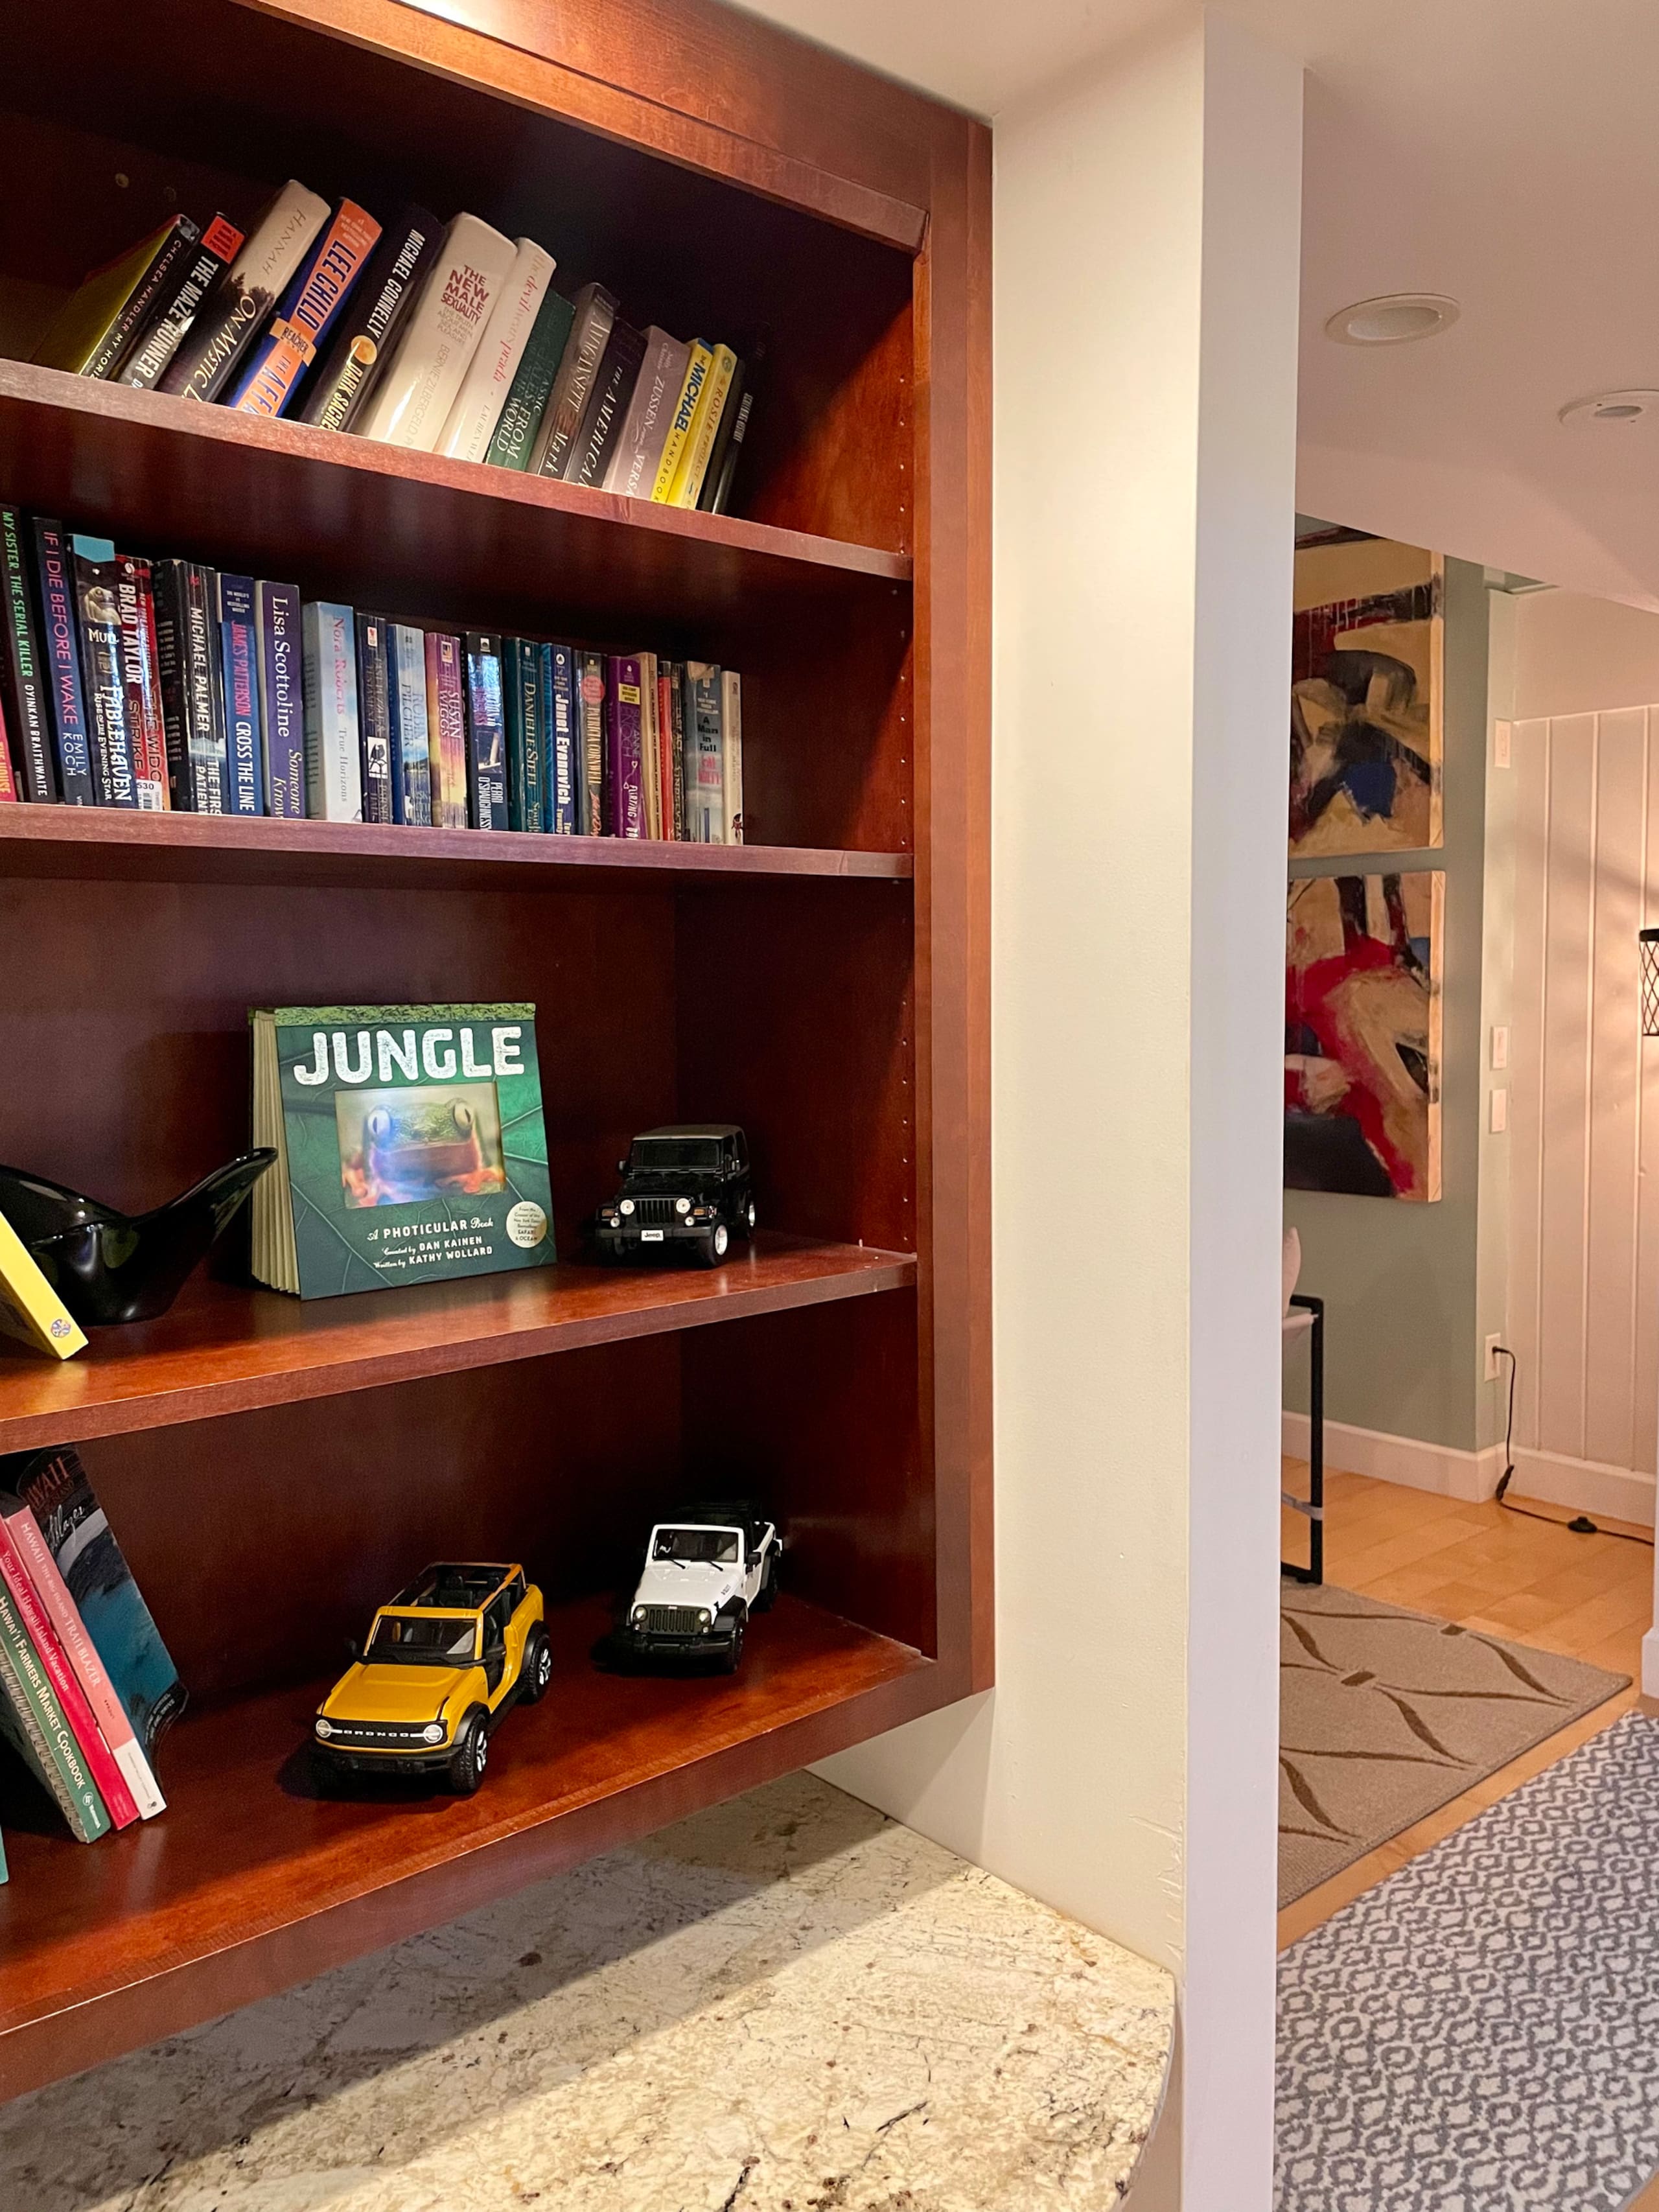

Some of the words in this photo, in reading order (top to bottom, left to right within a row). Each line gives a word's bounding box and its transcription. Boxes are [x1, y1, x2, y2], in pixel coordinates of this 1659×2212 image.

[152, 239, 181, 283] CHELSEA
[262, 207, 307, 275] HANNAH
[322, 240, 357, 283] LEE
[392, 228, 426, 281] MICHAEL
[191, 255, 219, 287] THE
[449, 269, 489, 302] NEW
[463, 264, 487, 285] THE
[121, 285, 154, 332] HANDLER
[168, 281, 203, 324] MAZE
[231, 295, 257, 330] ON
[296, 272, 339, 331] CHILD
[366, 279, 403, 339] CONNELLY
[440, 292, 481, 325] SEXUALITY
[445, 283, 485, 316] MALE
[518, 279, 539, 312] devil
[112, 332, 124, 349] MY
[135, 318, 184, 379] RUNNER
[194, 323, 238, 388] MYSTIC
[281, 325, 309, 353] REACHER
[431, 343, 450, 378] BERNIE
[275, 355, 292, 375] THE
[338, 360, 364, 400] DARK
[493, 340, 512, 383] prada
[612, 366, 623, 385] THE
[644, 375, 666, 431] ZUSSEN
[673, 362, 706, 433] MICHAEL
[706, 388, 724, 431] ROSIE
[496, 397, 522, 452] WORLD
[506, 406, 531, 459] FROM
[545, 430, 569, 473] Mark
[652, 433, 682, 502] HANDBOOK
[2, 511, 16, 530] MY
[43, 531, 59, 547] IF
[10, 575, 23, 597] THE
[46, 559, 64, 589] DIE
[13, 601, 29, 637] SERIAL
[118, 583, 139, 624] BRAD
[272, 595, 290, 636] Lisa
[51, 592, 72, 661] BEFORE
[191, 607, 207, 669] MICHAEL
[231, 619, 248, 657] JAMES
[333, 616, 346, 653] Nora
[17, 639, 33, 677] KILLER
[122, 629, 143, 685] TAYLOR
[24, 684, 40, 728] OYINKAN
[60, 675, 79, 725] WAKE
[194, 674, 211, 732] PALMER
[233, 658, 251, 717] PATTERSON
[274, 640, 294, 738] Scottoline
[334, 658, 348, 716] Roberts
[400, 683, 414, 747] PILCHER
[412, 693, 426, 744] ROBIN
[439, 690, 452, 738] WIGGS
[447, 690, 462, 739] SUSAN
[524, 681, 537, 747] DANIELLE
[555, 693, 569, 733] Janet
[586, 707, 601, 743] PATRICIA
[621, 704, 634, 758] ENOCH
[697, 724, 719, 734] Man
[62, 732, 77, 776] KOCH
[73, 733, 87, 776] EMILY
[98, 736, 110, 777] EVENING
[129, 699, 144, 771] STRIKE
[235, 721, 253, 760] CROSS
[338, 727, 348, 753] True
[699, 743, 717, 752] Full
[702, 734, 712, 743] in
[30, 730, 49, 797] BRAITHWAITE
[207, 760, 221, 784] THE
[237, 762, 254, 784] THE
[288, 748, 303, 815] Someone
[339, 756, 349, 803] Horizons
[526, 747, 539, 789] STEEL
[555, 736, 572, 805] Evanovich
[587, 743, 602, 786] CORNWELL
[101, 777, 113, 801] STAR
[238, 785, 255, 812] LINE
[491, 780, 504, 805] PERRI
[627, 784, 638, 818] FLIRTING
[293, 1026, 525, 1086] JUNGLE
[382, 1219, 468, 1240] PHOTICULAR
[419, 1239, 441, 1252] DAN
[444, 1236, 483, 1249] KAINEN
[408, 1252, 443, 1265] KATHY
[447, 1246, 493, 1259] WOLLARD
[3, 1550, 16, 1577] Your
[48, 1647, 70, 1692] Vacation
[21, 1522, 46, 1564] HAWAII
[76, 1647, 102, 1688] BLAZER
[15, 1637, 41, 1689] FARMERS
[36, 1685, 62, 1732] MARKET
[56, 1730, 86, 1790] COOKBOOK
